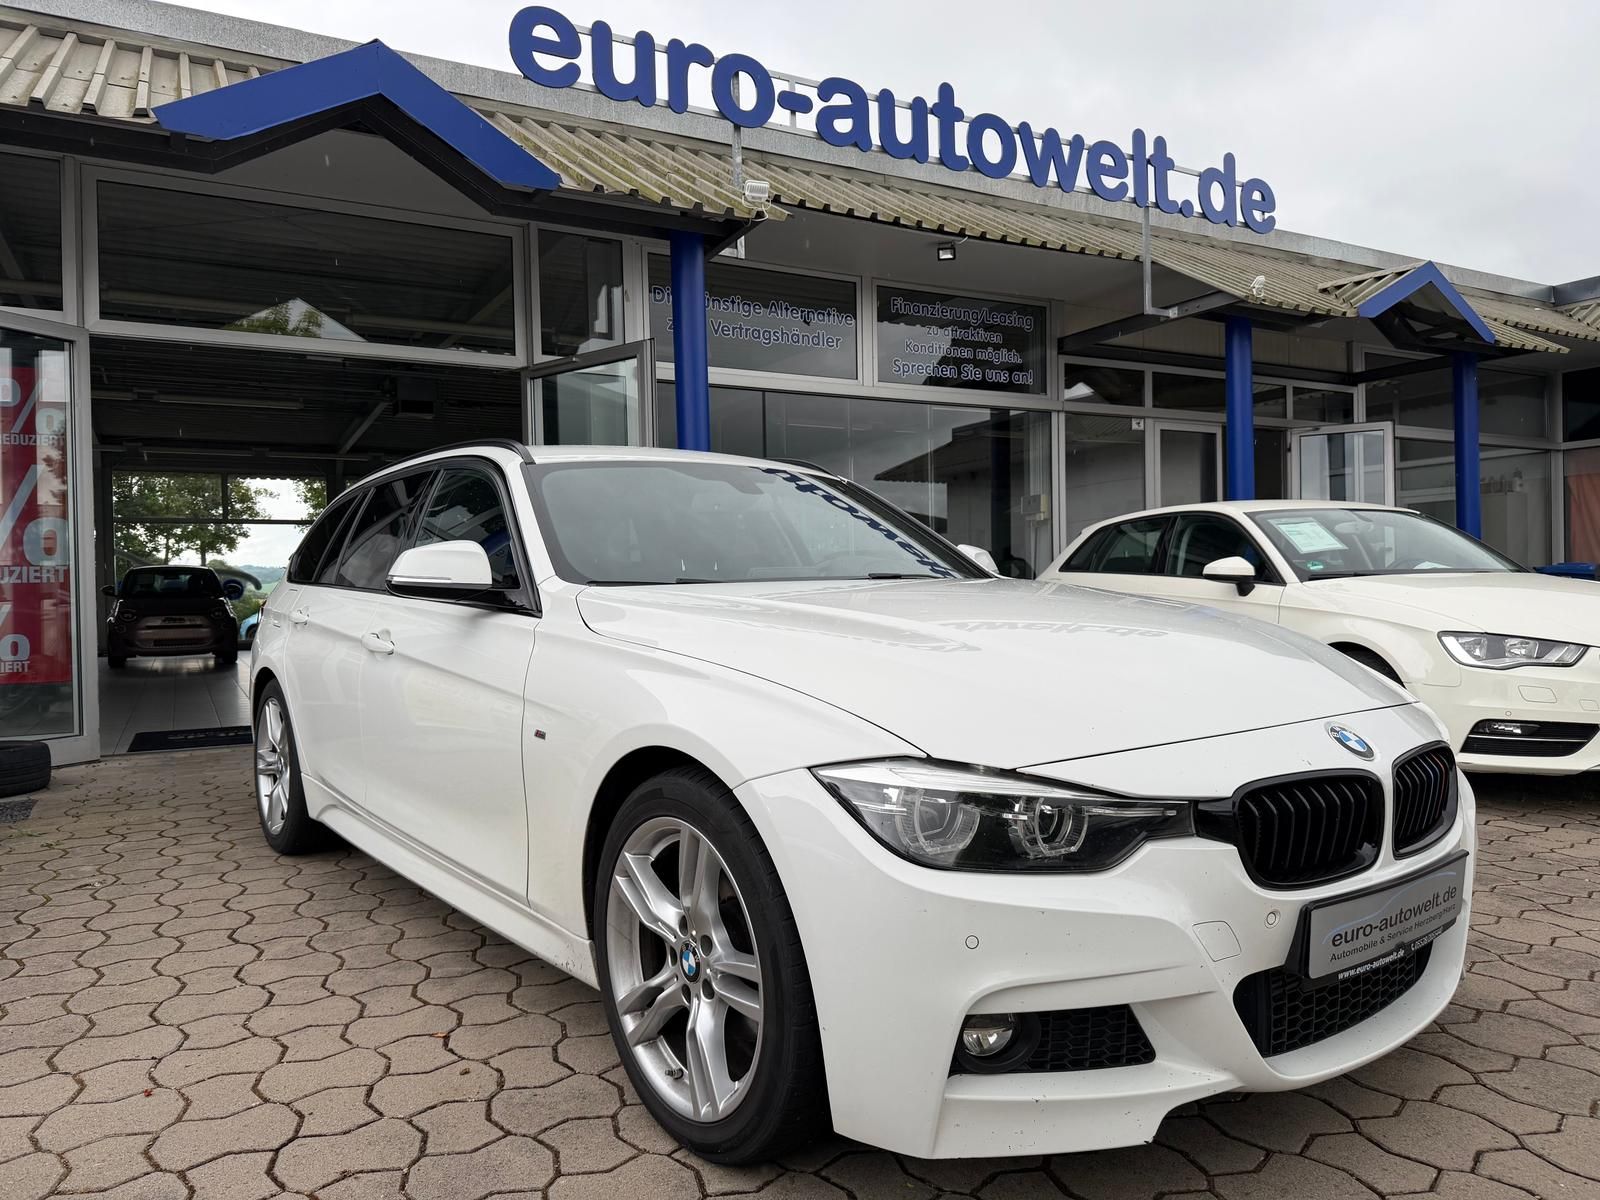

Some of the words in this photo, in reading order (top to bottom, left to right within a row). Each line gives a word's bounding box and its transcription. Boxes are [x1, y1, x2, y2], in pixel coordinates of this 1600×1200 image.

[509, 6, 1276, 234] euro-autowelt.de
[652, 285, 673, 304] Di
[704, 291, 763, 318] ünstige
[768, 301, 855, 328] Alternative
[890, 297, 1034, 332] Finanzierung/Leasing
[710, 319, 842, 349] Vertragshändler
[926, 325, 939, 337] zu
[943, 326, 1003, 344] attraktiven
[904, 339, 974, 359] Konditionen
[976, 348, 1023, 365] möglich.
[892, 358, 957, 378] Sprechen
[961, 363, 982, 380] Sie
[985, 370, 1009, 384] uns
[1011, 369, 1034, 385] an!
[1331, 885, 1457, 947] euro-autowelt.de
[1329, 940, 1378, 963] Automobile
[1379, 935, 1385, 945] &
[1387, 925, 1413, 941] Service
